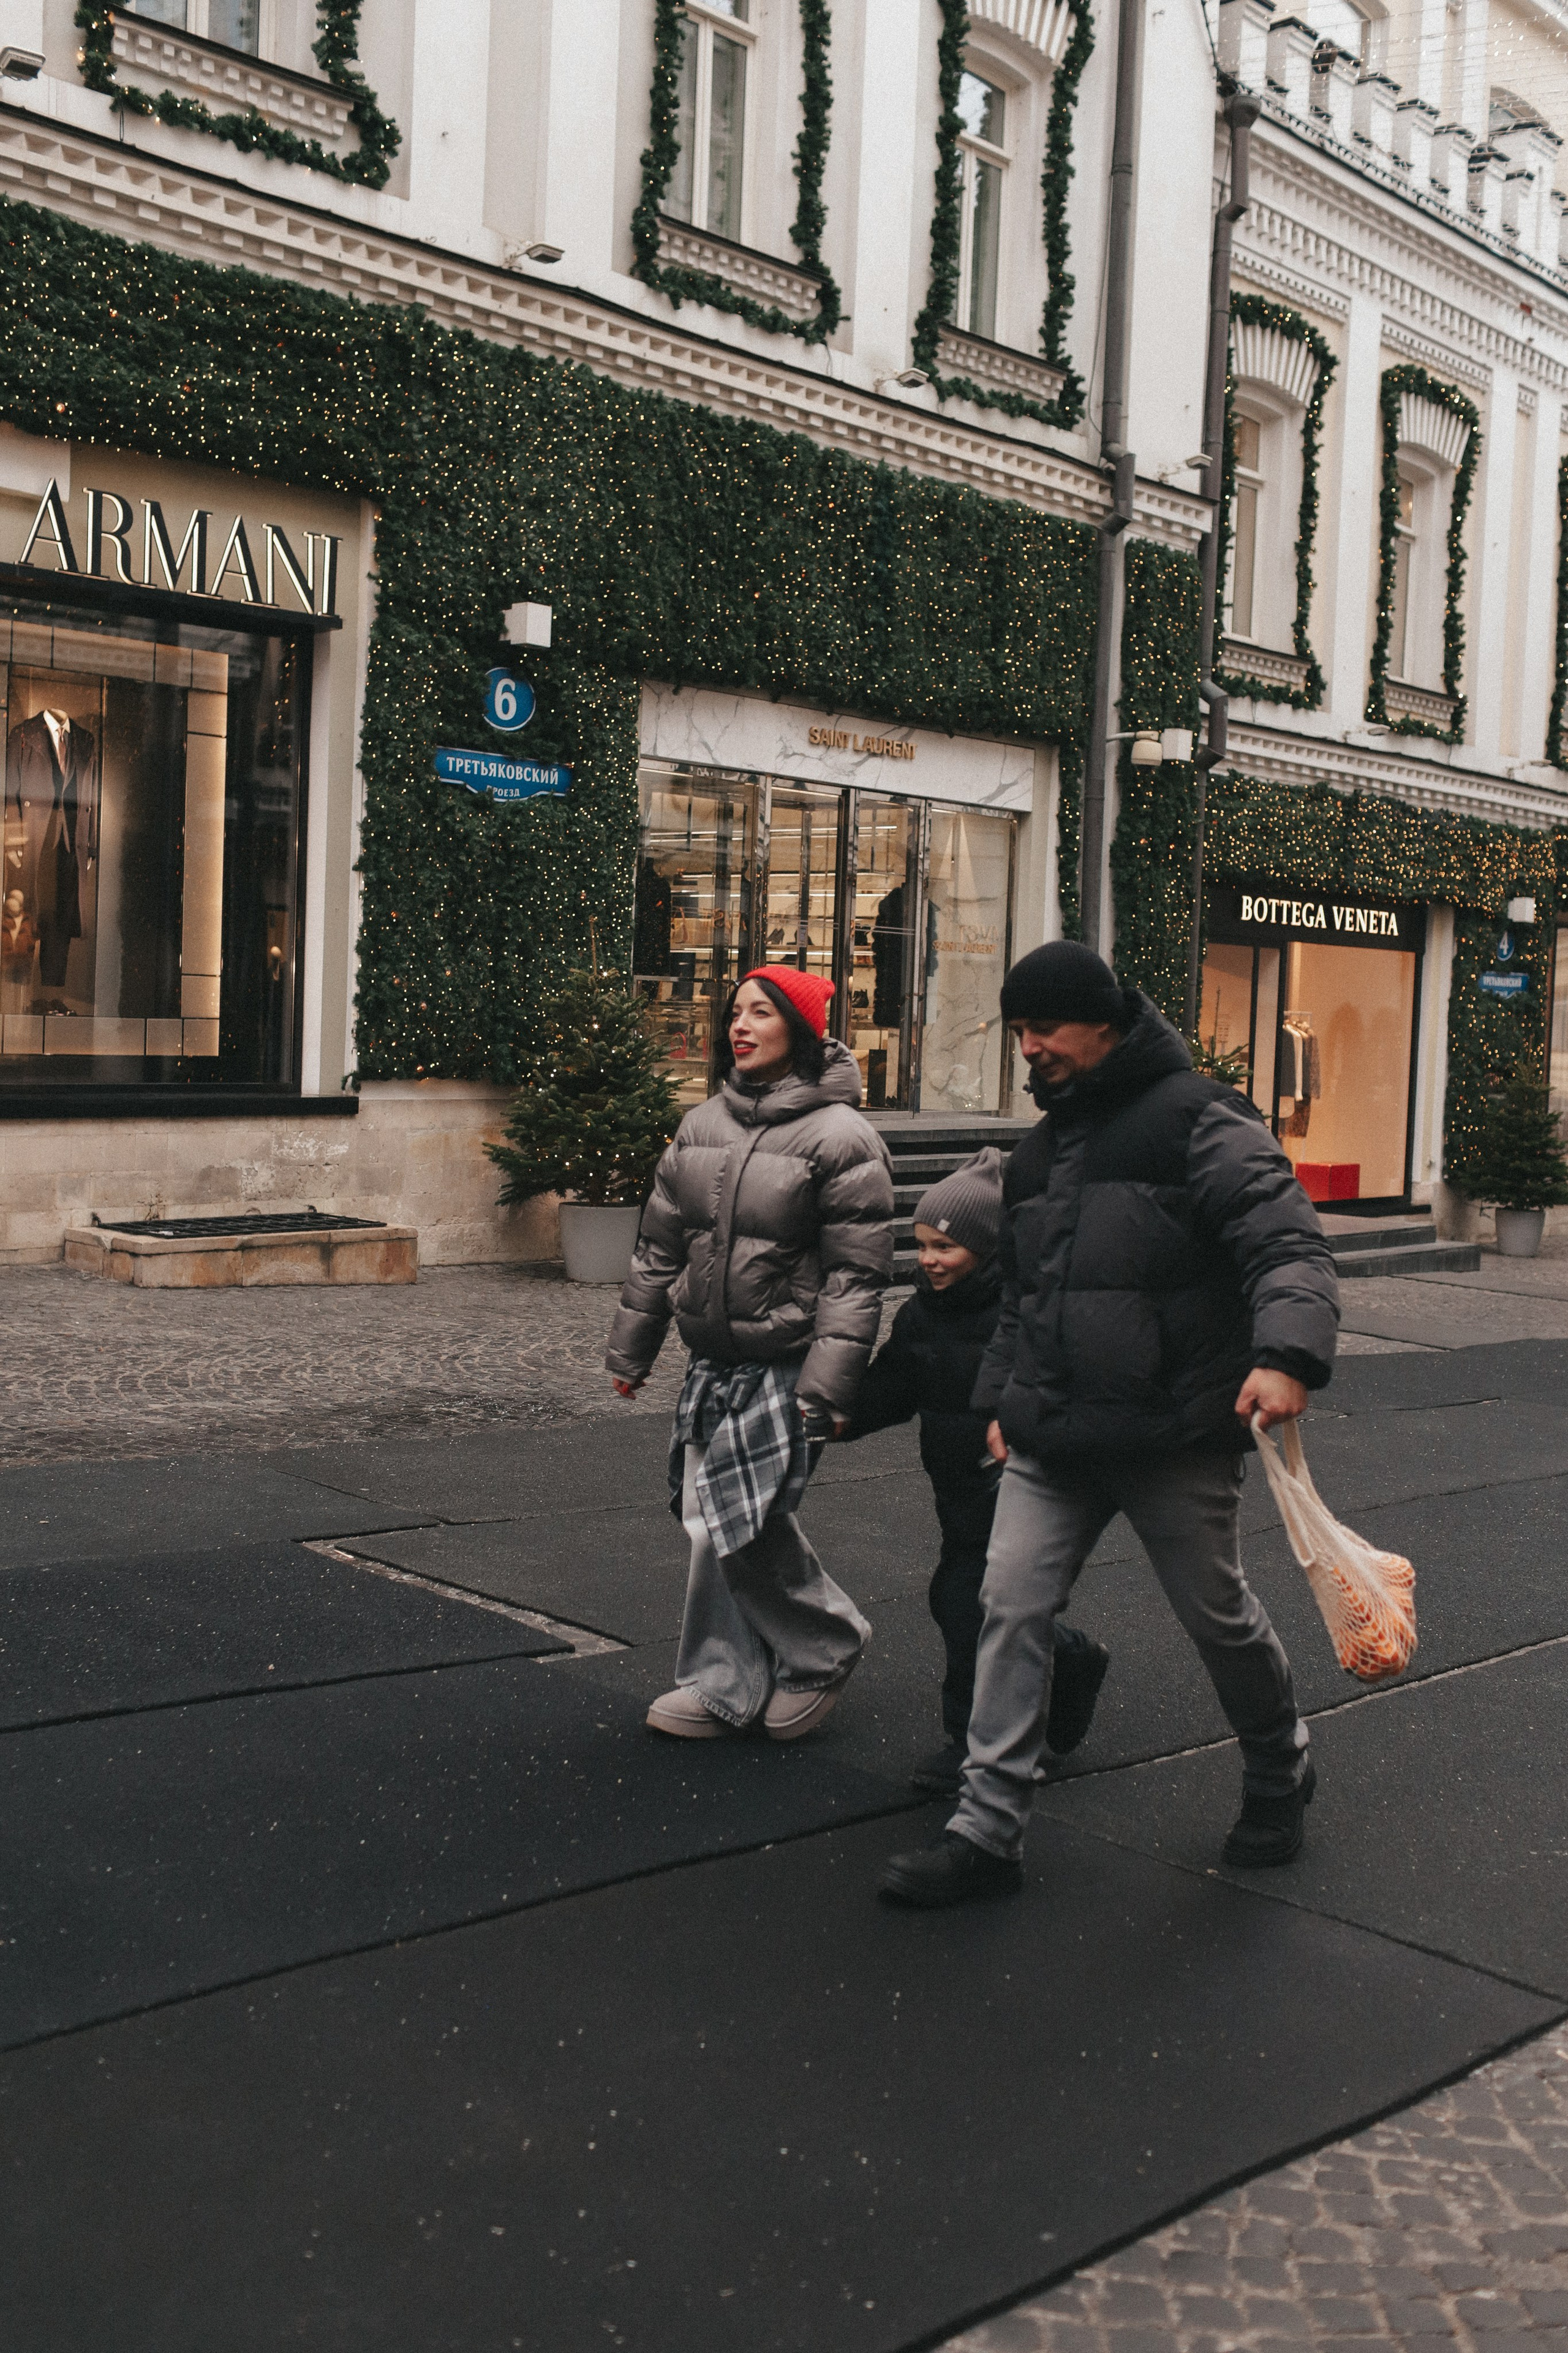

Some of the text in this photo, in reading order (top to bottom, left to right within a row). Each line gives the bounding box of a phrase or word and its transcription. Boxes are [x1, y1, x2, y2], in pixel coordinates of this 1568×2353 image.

[15, 477, 343, 616] ARMANI
[494, 678, 517, 720] 6
[809, 726, 918, 760] SAINT LAURENT
[447, 757, 559, 785] ТРЕТЬЯКОВСКИЙ
[1241, 895, 1399, 936] BOTTEGA VENETA
[1499, 931, 1509, 955] 4
